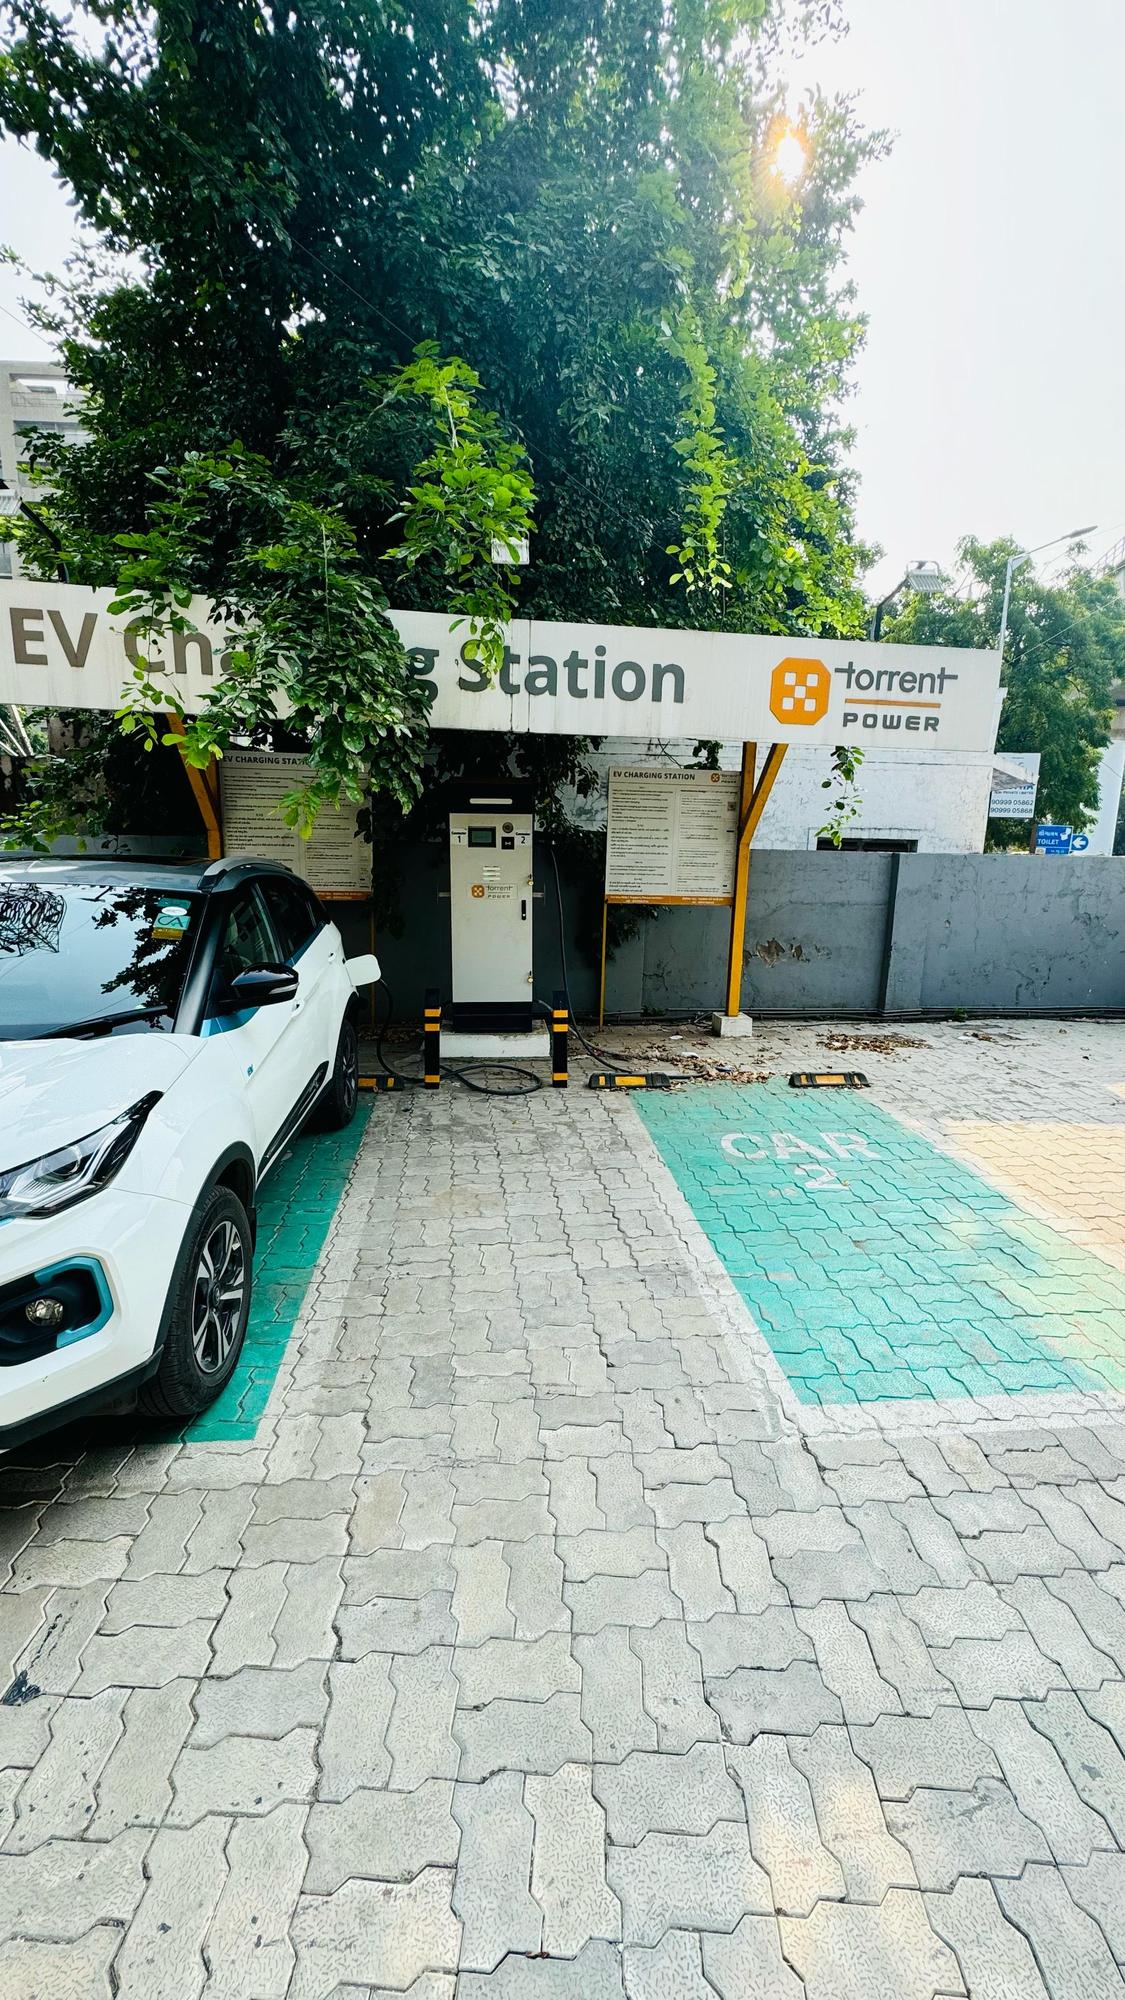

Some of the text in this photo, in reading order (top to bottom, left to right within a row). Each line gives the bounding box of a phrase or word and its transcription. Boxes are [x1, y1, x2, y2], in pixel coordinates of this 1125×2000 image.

[9, 608, 98, 668] EV
[458, 639, 685, 704] Station
[834, 661, 958, 694] torrent
[842, 712, 940, 732] POWER
[223, 755, 233, 763] EV
[235, 756, 280, 765] CHARGING
[613, 770, 622, 778] EV
[624, 771, 663, 779] CHARGING
[457, 835, 461, 844] 1
[521, 836, 526, 844] 2
[720, 1132, 882, 1159] CAR
[794, 1164, 850, 1190] 2
